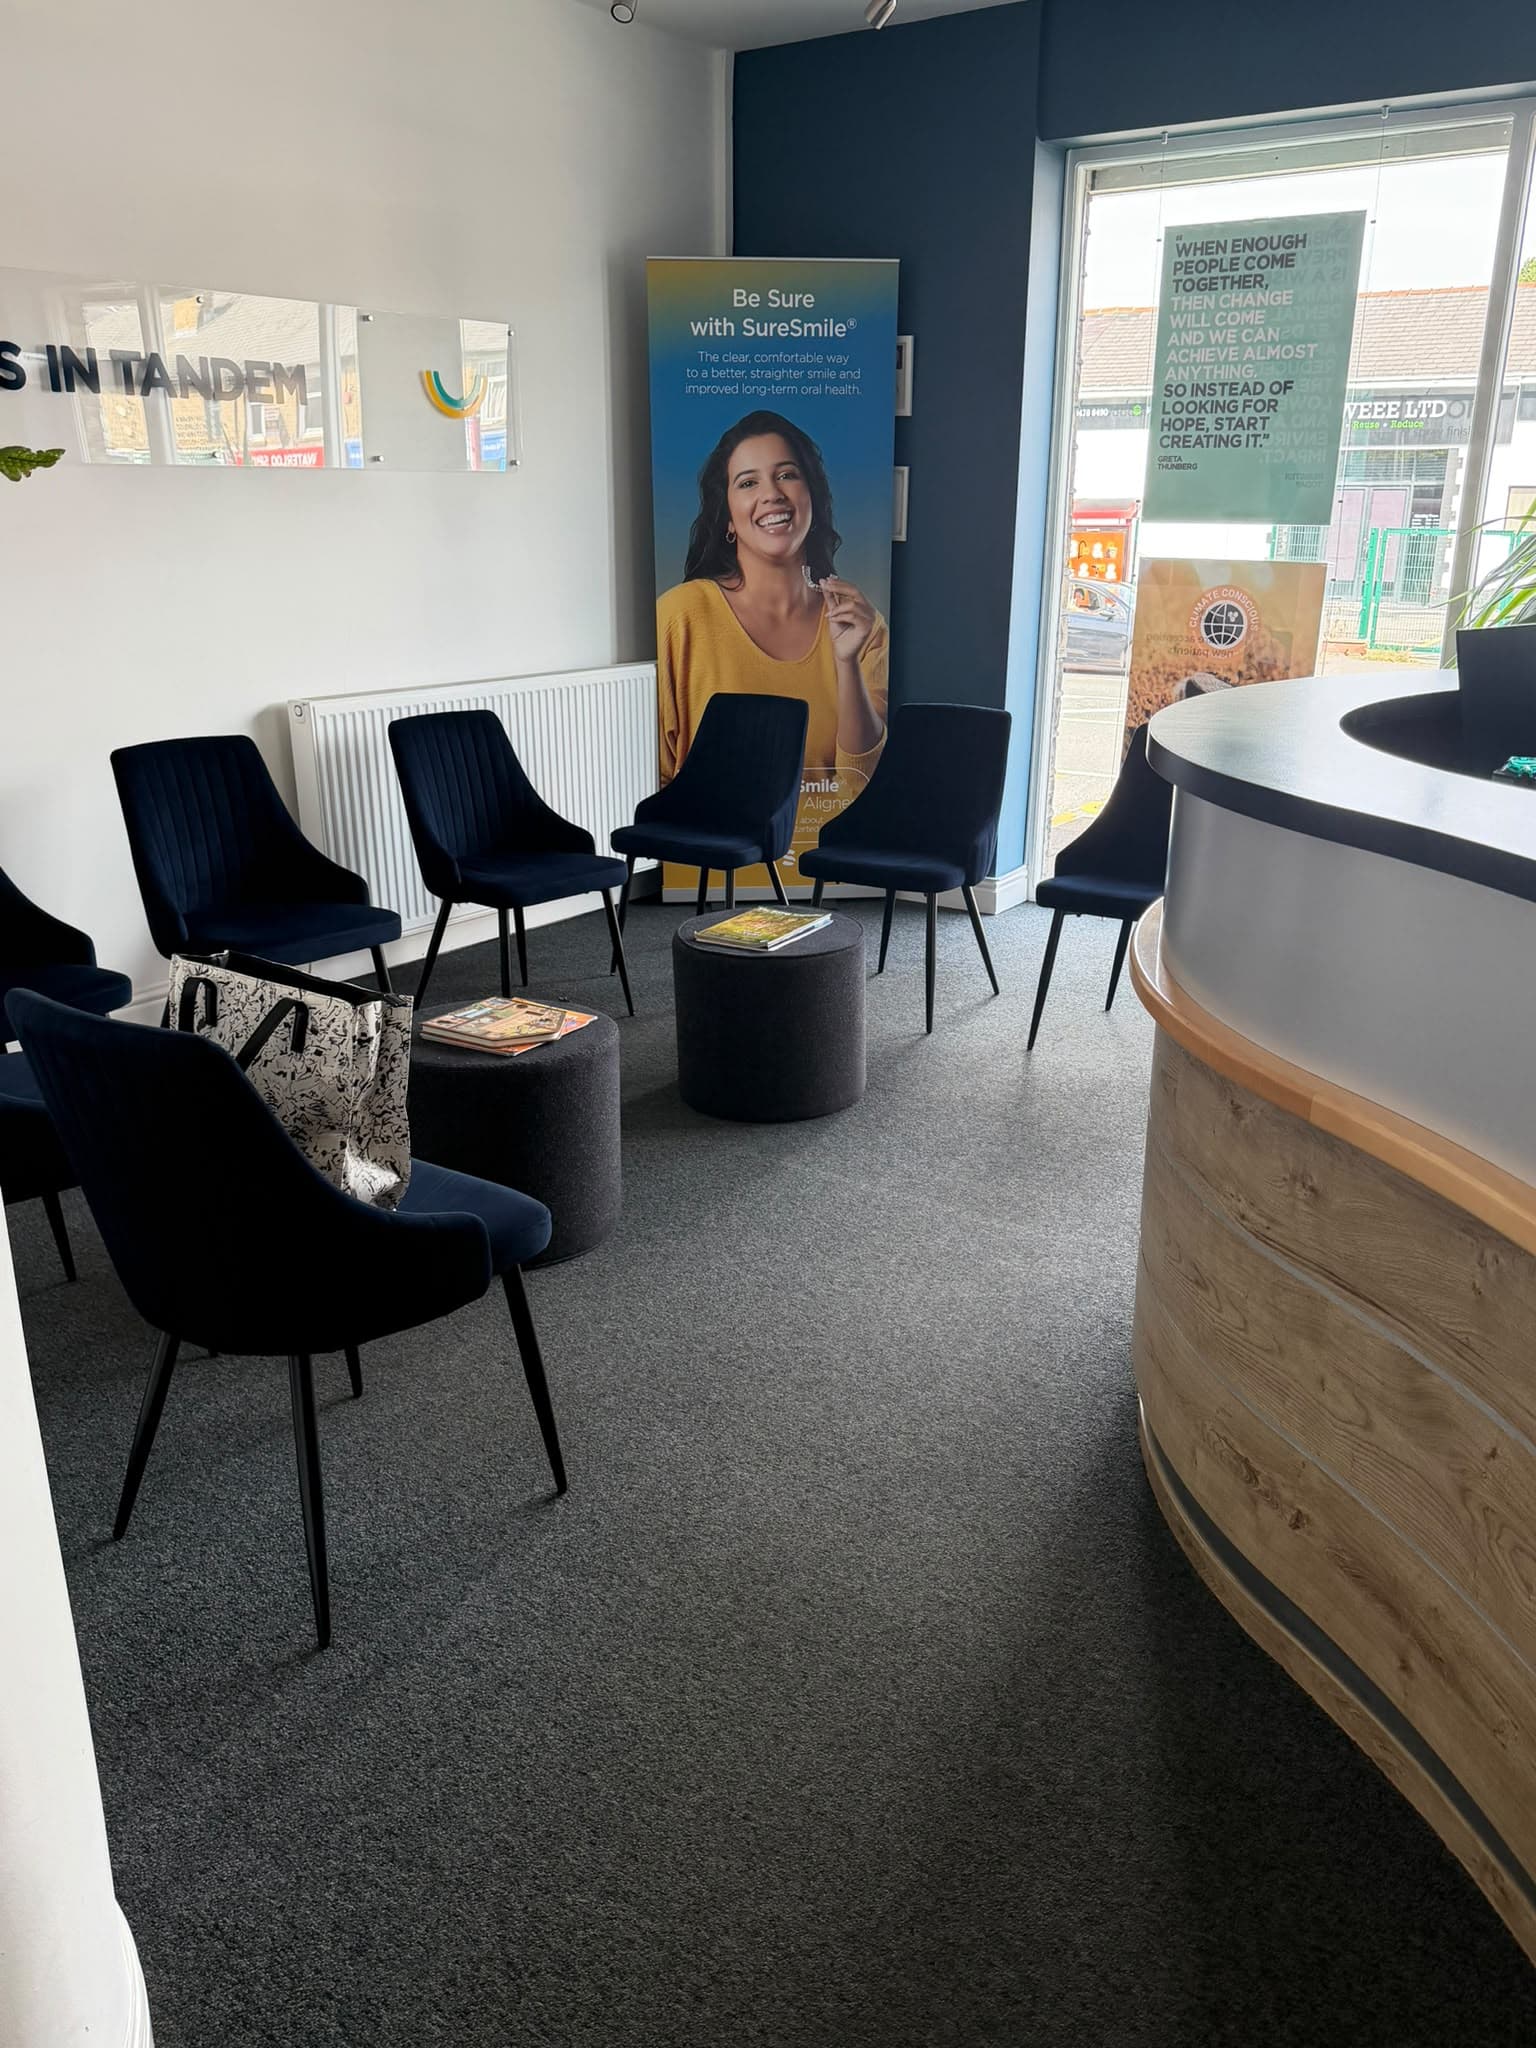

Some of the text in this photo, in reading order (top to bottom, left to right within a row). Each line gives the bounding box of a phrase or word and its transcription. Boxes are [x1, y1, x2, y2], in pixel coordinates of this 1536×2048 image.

[1230, 233, 1308, 252] ENOUGH
[1172, 257, 1241, 276] PEOPLE
[1243, 252, 1296, 271] COME
[1172, 273, 1269, 293] TOGETHER,
[732, 288, 815, 308] Be Sure
[1170, 293, 1216, 311] THEN
[1218, 290, 1294, 308] CHANGE
[690, 317, 735, 337] with
[1169, 310, 1266, 329] WILL COME
[1167, 330, 1205, 347] AND
[1208, 329, 1237, 345] WE
[1241, 328, 1280, 343] CAN
[698, 350, 849, 366] The clear, comfortable way
[1166, 343, 1318, 365] ACHIEVE ALMOST
[45, 343, 101, 394] IN
[109, 348, 308, 406] TANDEM
[686, 368, 861, 381] to a better, straighter smile and
[1164, 364, 1258, 382] ANYTHING.
[685, 383, 862, 396] improved long-term oral health.
[1163, 382, 1188, 399] SO
[1190, 381, 1264, 398] INSTEAD
[1268, 380, 1295, 396] OF
[1161, 399, 1240, 415] LOOKING
[1241, 398, 1279, 414] FOR
[1404, 400, 1448, 419] LTD
[1160, 415, 1270, 433] HOPE, START
[1352, 419, 1424, 430] Reuse Reduce
[1159, 433, 1242, 449] CREATING
[1157, 455, 1183, 463] GRETA
[1157, 463, 1198, 471] THUNBERG
[1189, 588, 1259, 632] CLIMATE CONSCIOUS
[803, 796, 855, 813] Aligne
